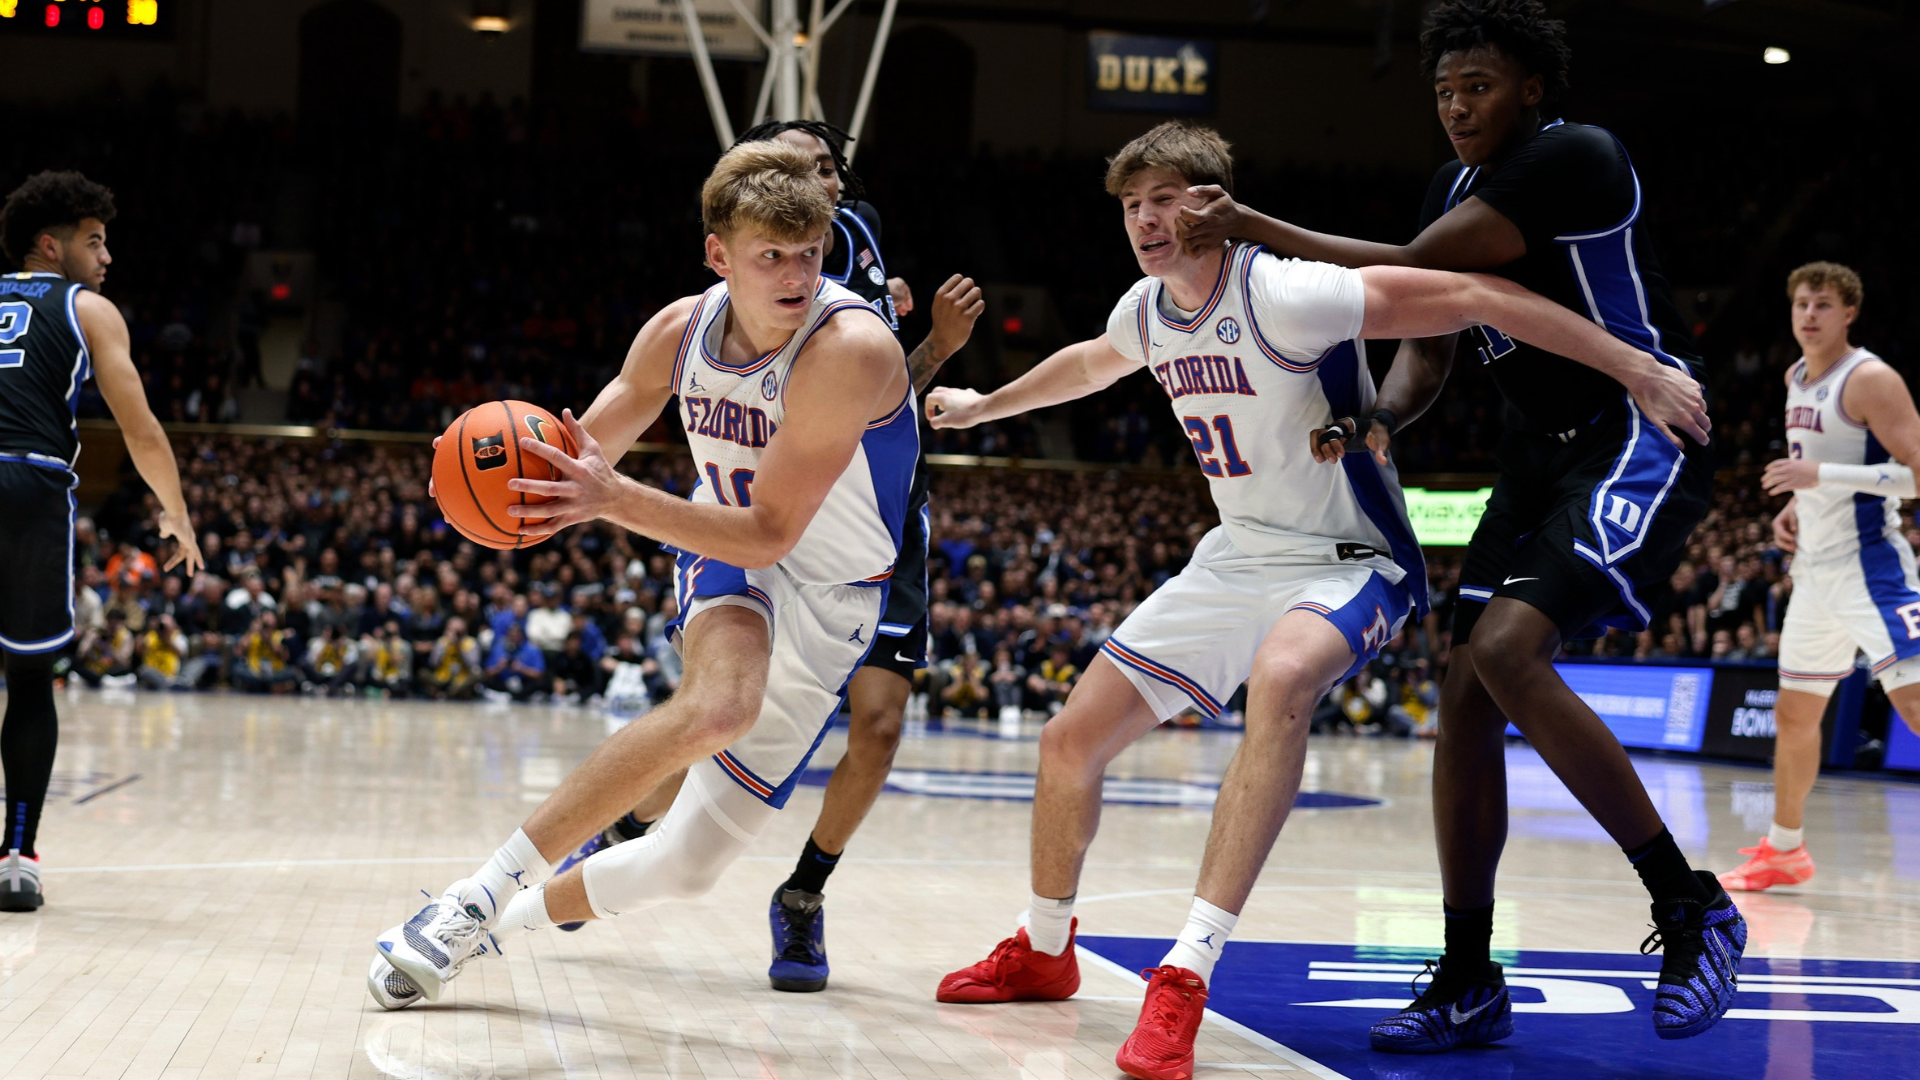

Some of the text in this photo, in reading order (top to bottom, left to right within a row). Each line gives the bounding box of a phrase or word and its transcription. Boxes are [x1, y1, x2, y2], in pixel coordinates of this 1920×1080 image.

[1097, 54, 1207, 95] DUKE
[0, 301, 33, 368] 2
[1217, 318, 1240, 343] SEC
[1155, 355, 1257, 400] FLORIDA
[685, 396, 778, 448] FLORID
[1183, 414, 1252, 478] 21
[1605, 494, 1641, 533] D
